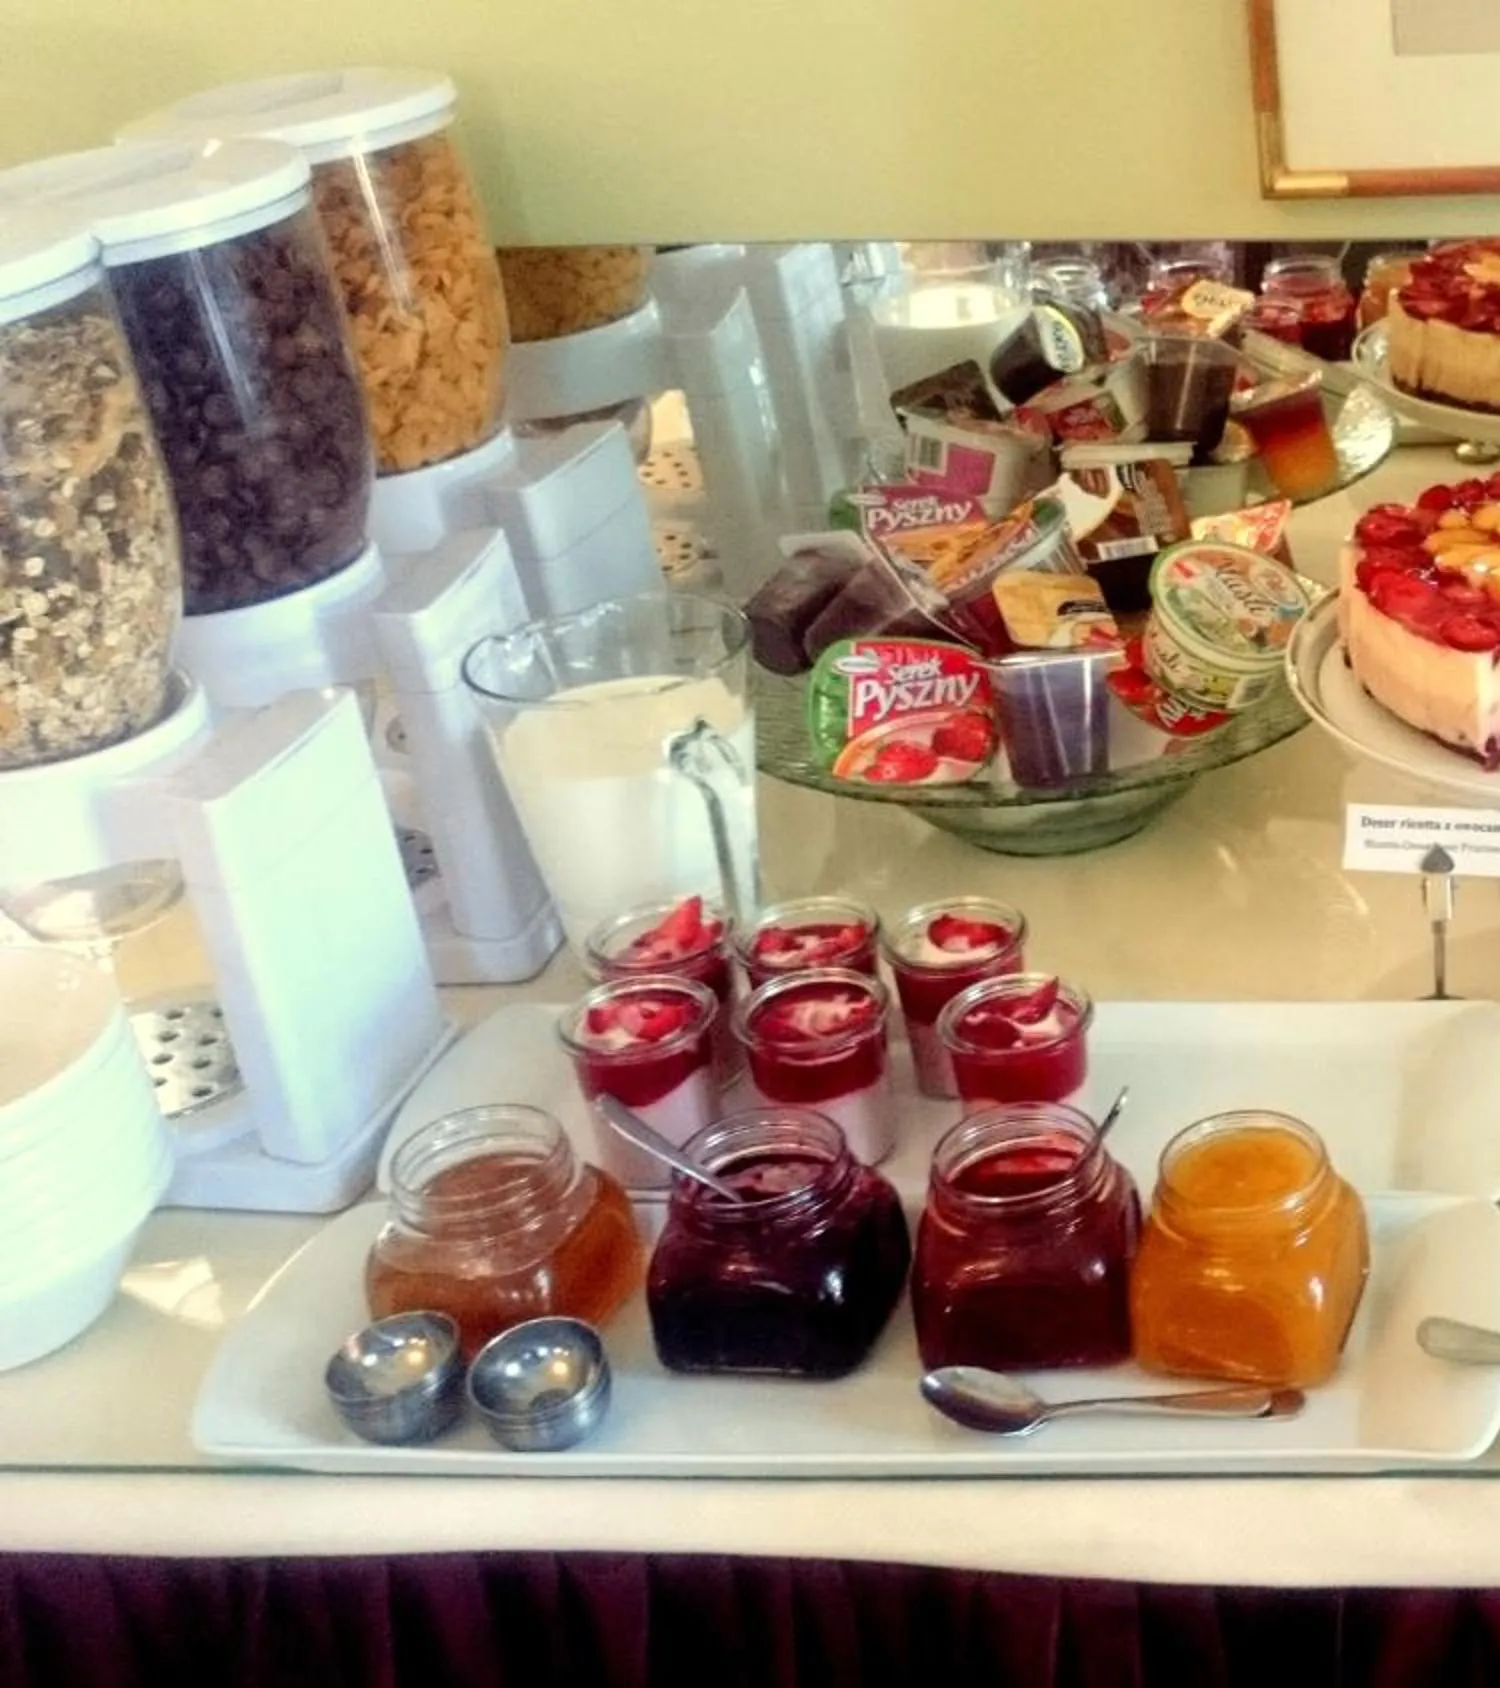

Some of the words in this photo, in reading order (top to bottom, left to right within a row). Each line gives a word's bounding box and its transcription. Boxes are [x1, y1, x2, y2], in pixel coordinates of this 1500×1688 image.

[867, 501, 972, 532] Pyszny
[888, 658, 943, 684] Serek
[853, 671, 981, 722] Pyszny
